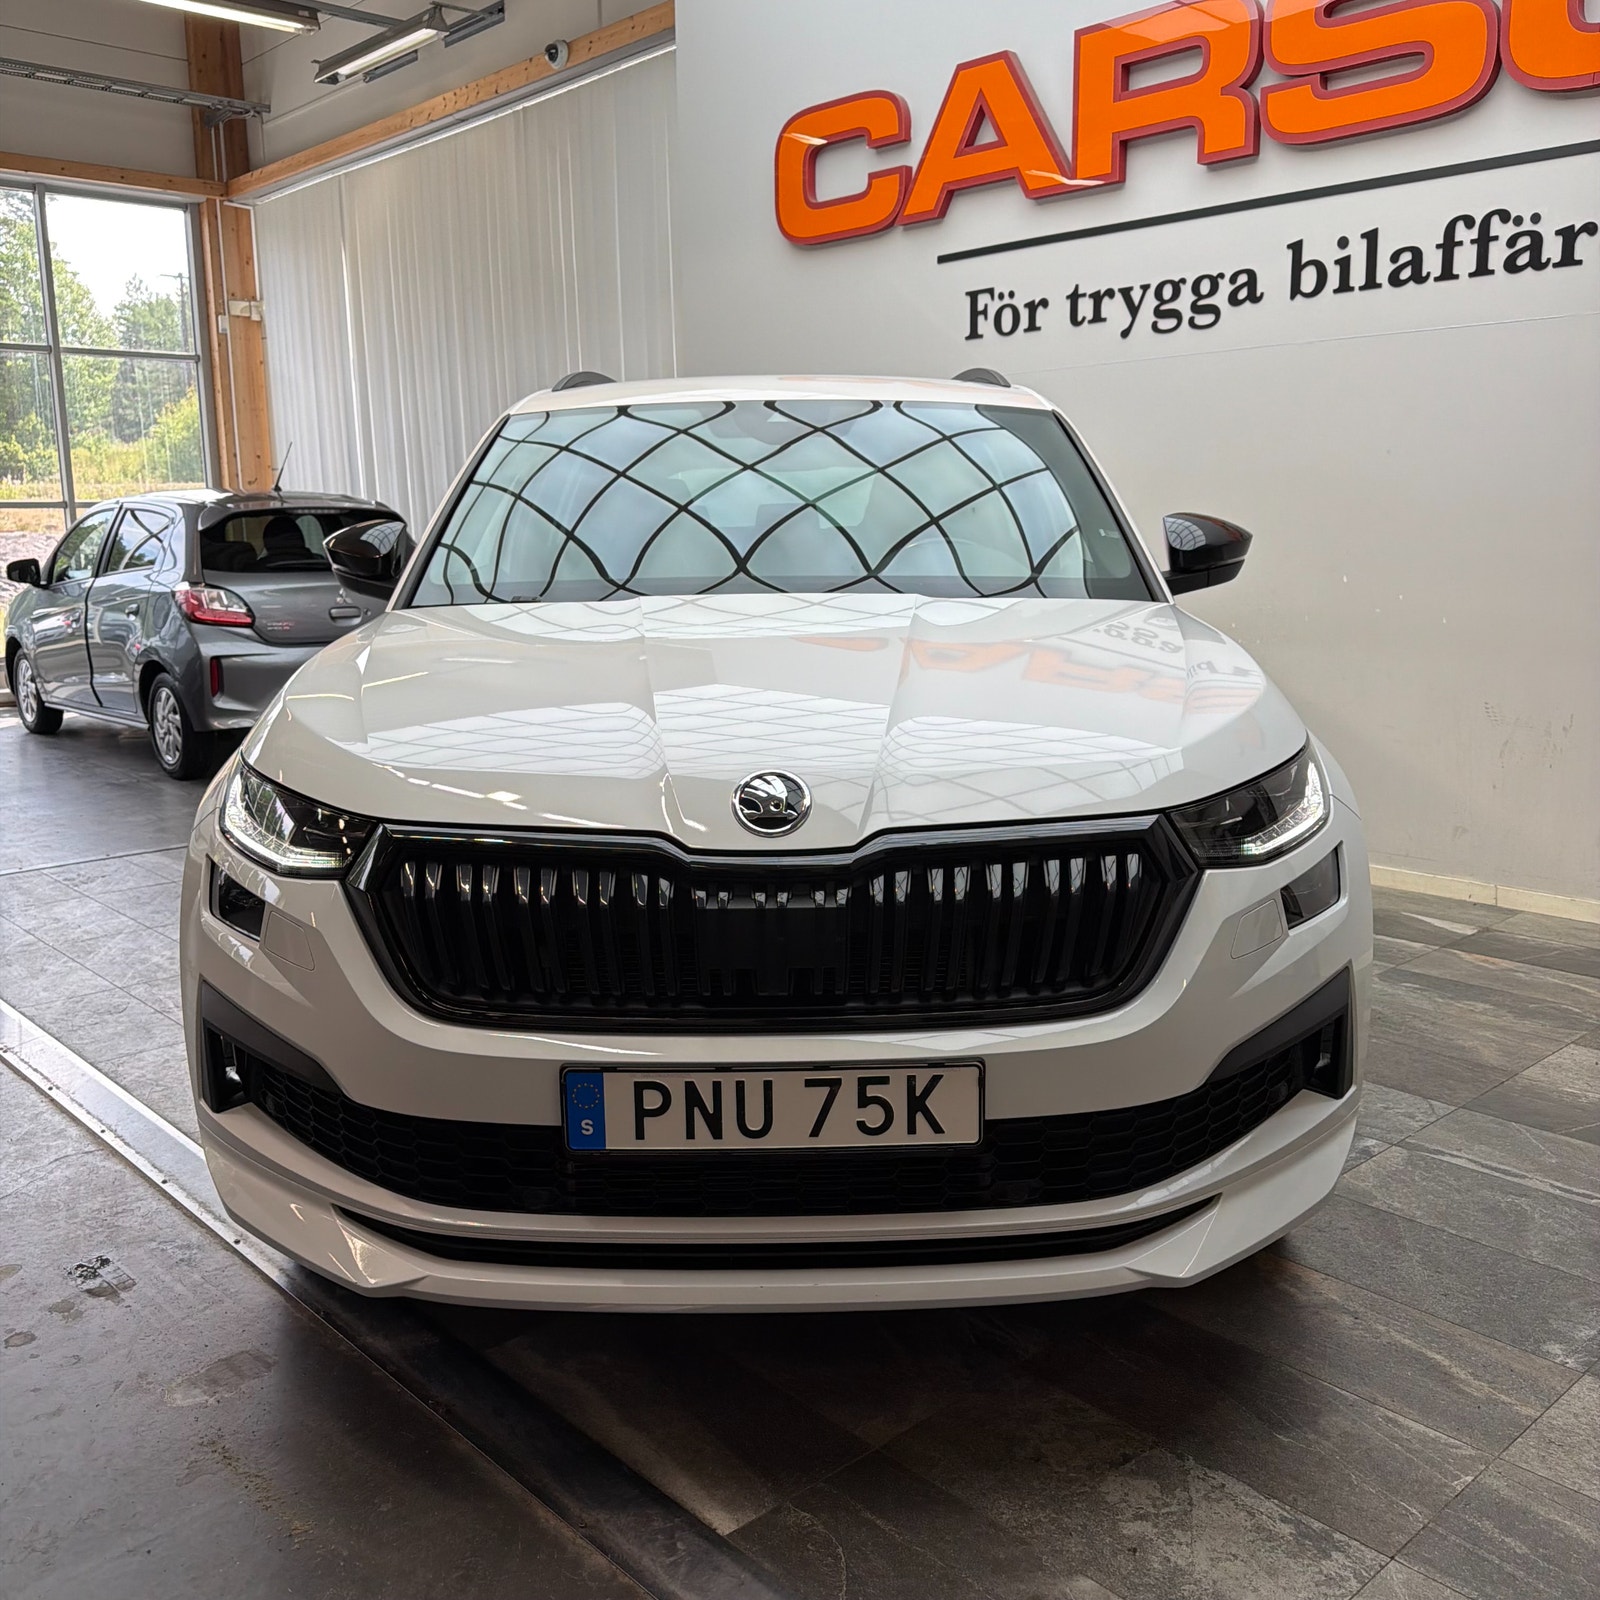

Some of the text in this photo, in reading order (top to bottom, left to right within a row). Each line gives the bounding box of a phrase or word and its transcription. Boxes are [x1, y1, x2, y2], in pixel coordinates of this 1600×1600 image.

[965, 287, 1049, 340] För
[1065, 268, 1265, 340] trygga
[580, 1119, 594, 1136] S
[633, 1074, 946, 1141] PNU 75K
